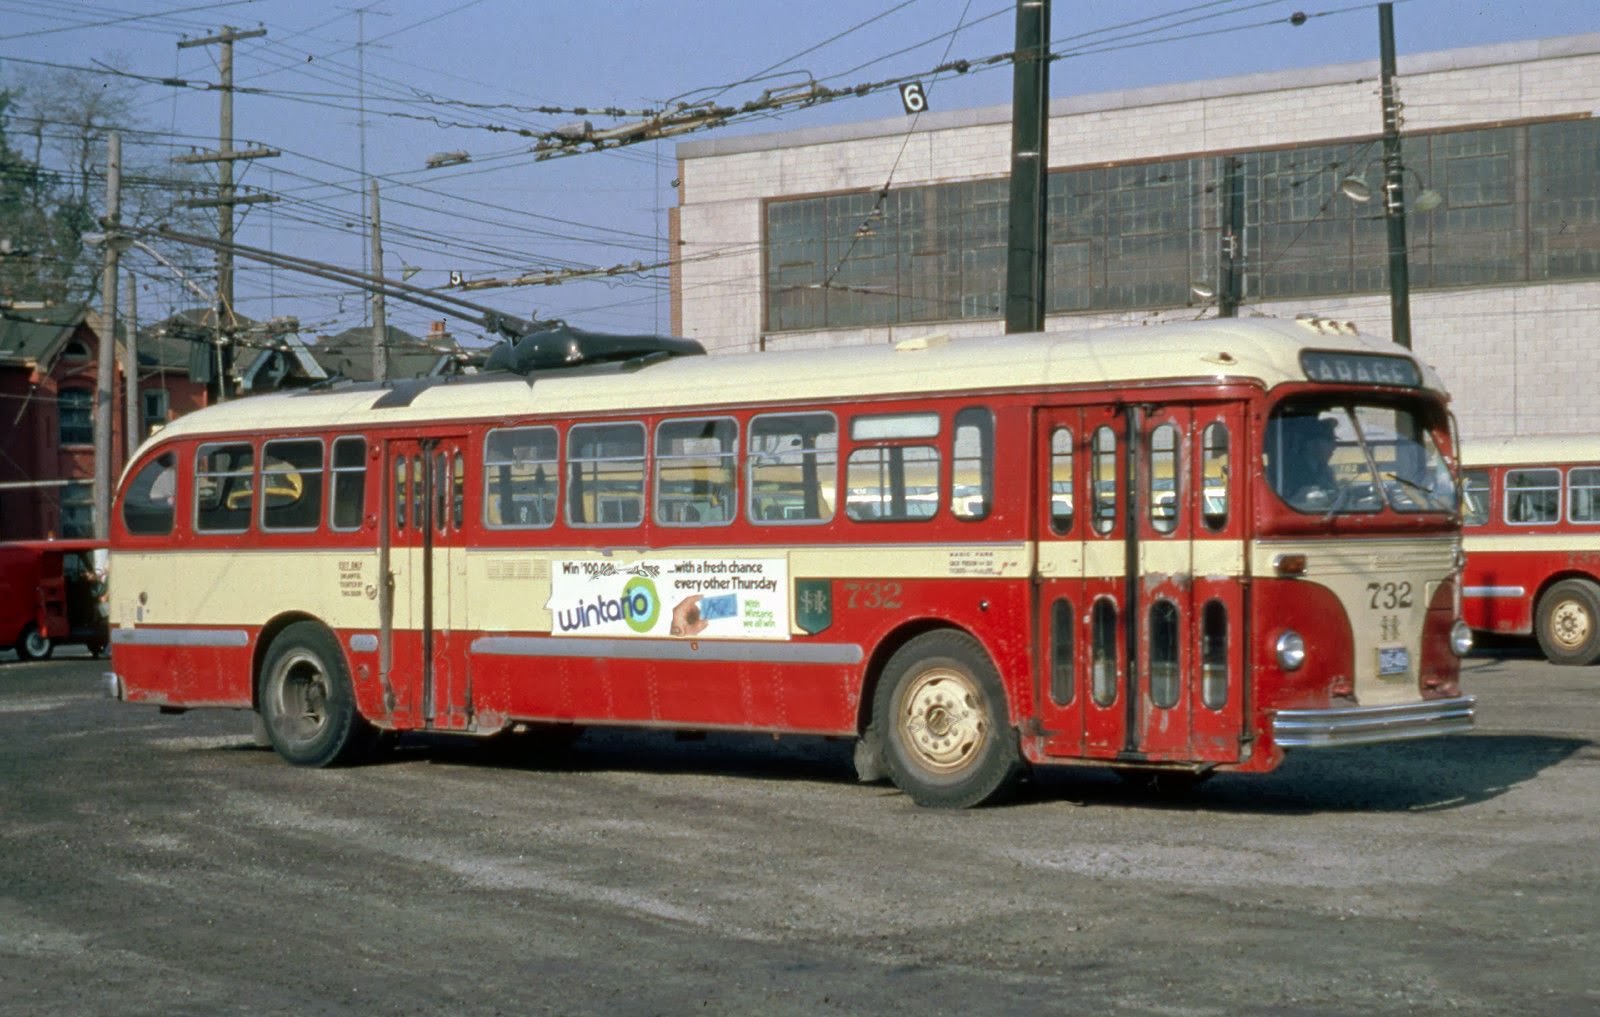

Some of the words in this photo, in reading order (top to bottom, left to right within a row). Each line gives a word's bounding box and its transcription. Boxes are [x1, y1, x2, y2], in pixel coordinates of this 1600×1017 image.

[904, 84, 924, 111] 6
[451, 271, 461, 285] 5
[562, 562, 579, 574] Win
[696, 564, 702, 573] a
[703, 561, 727, 574] fresh
[728, 561, 763, 574] chance
[674, 579, 701, 592] every
[703, 577, 730, 590] other
[731, 576, 777, 592] Thursday
[844, 583, 903, 609] 732
[1367, 581, 1412, 609] 732
[558, 588, 648, 631] wintario
